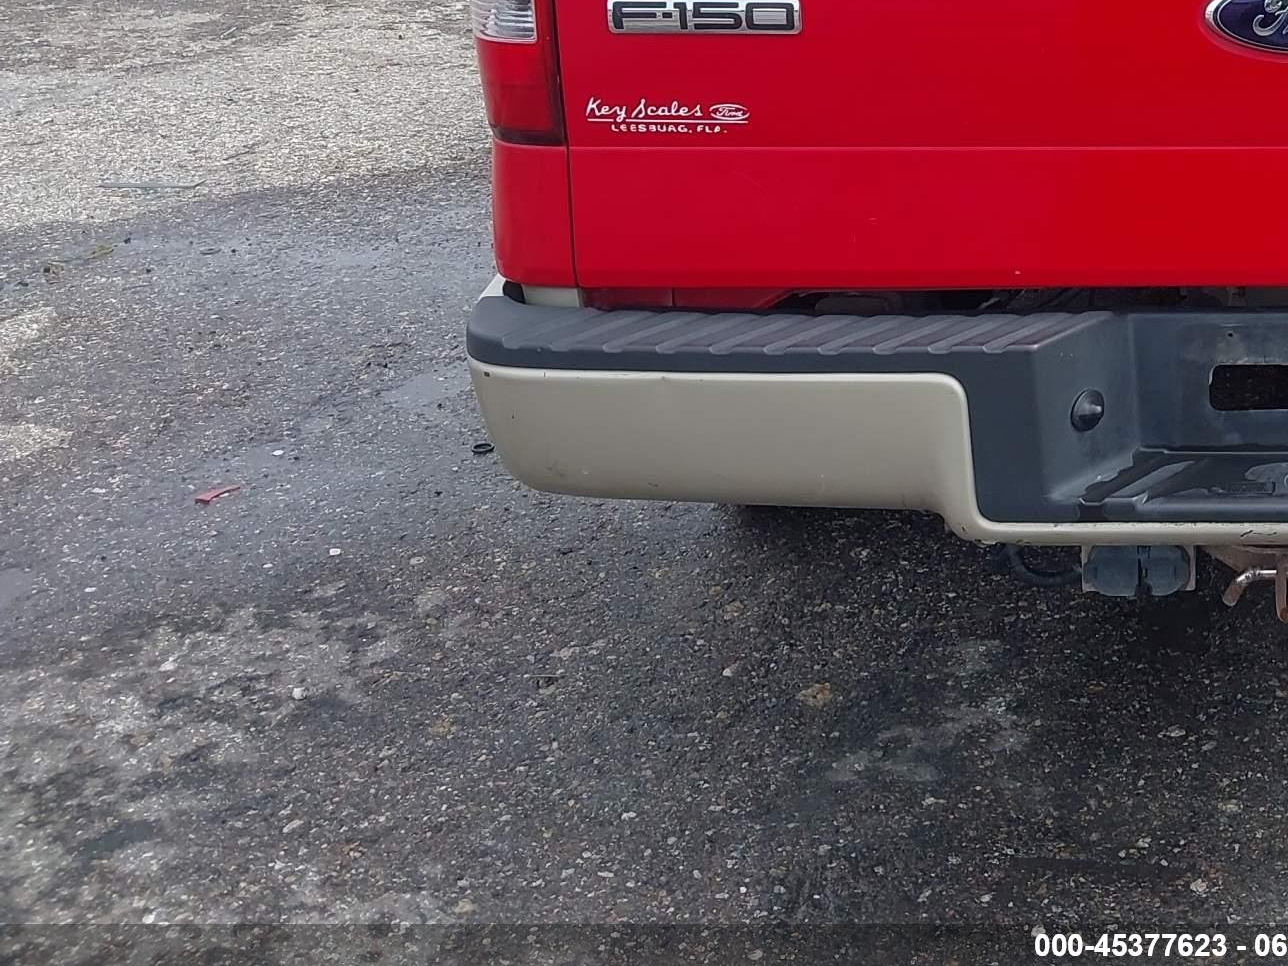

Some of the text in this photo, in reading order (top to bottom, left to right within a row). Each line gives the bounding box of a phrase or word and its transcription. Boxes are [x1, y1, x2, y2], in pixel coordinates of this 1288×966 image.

[611, 1, 796, 31] F-150
[585, 97, 627, 122] Key
[631, 98, 703, 118] Scales
